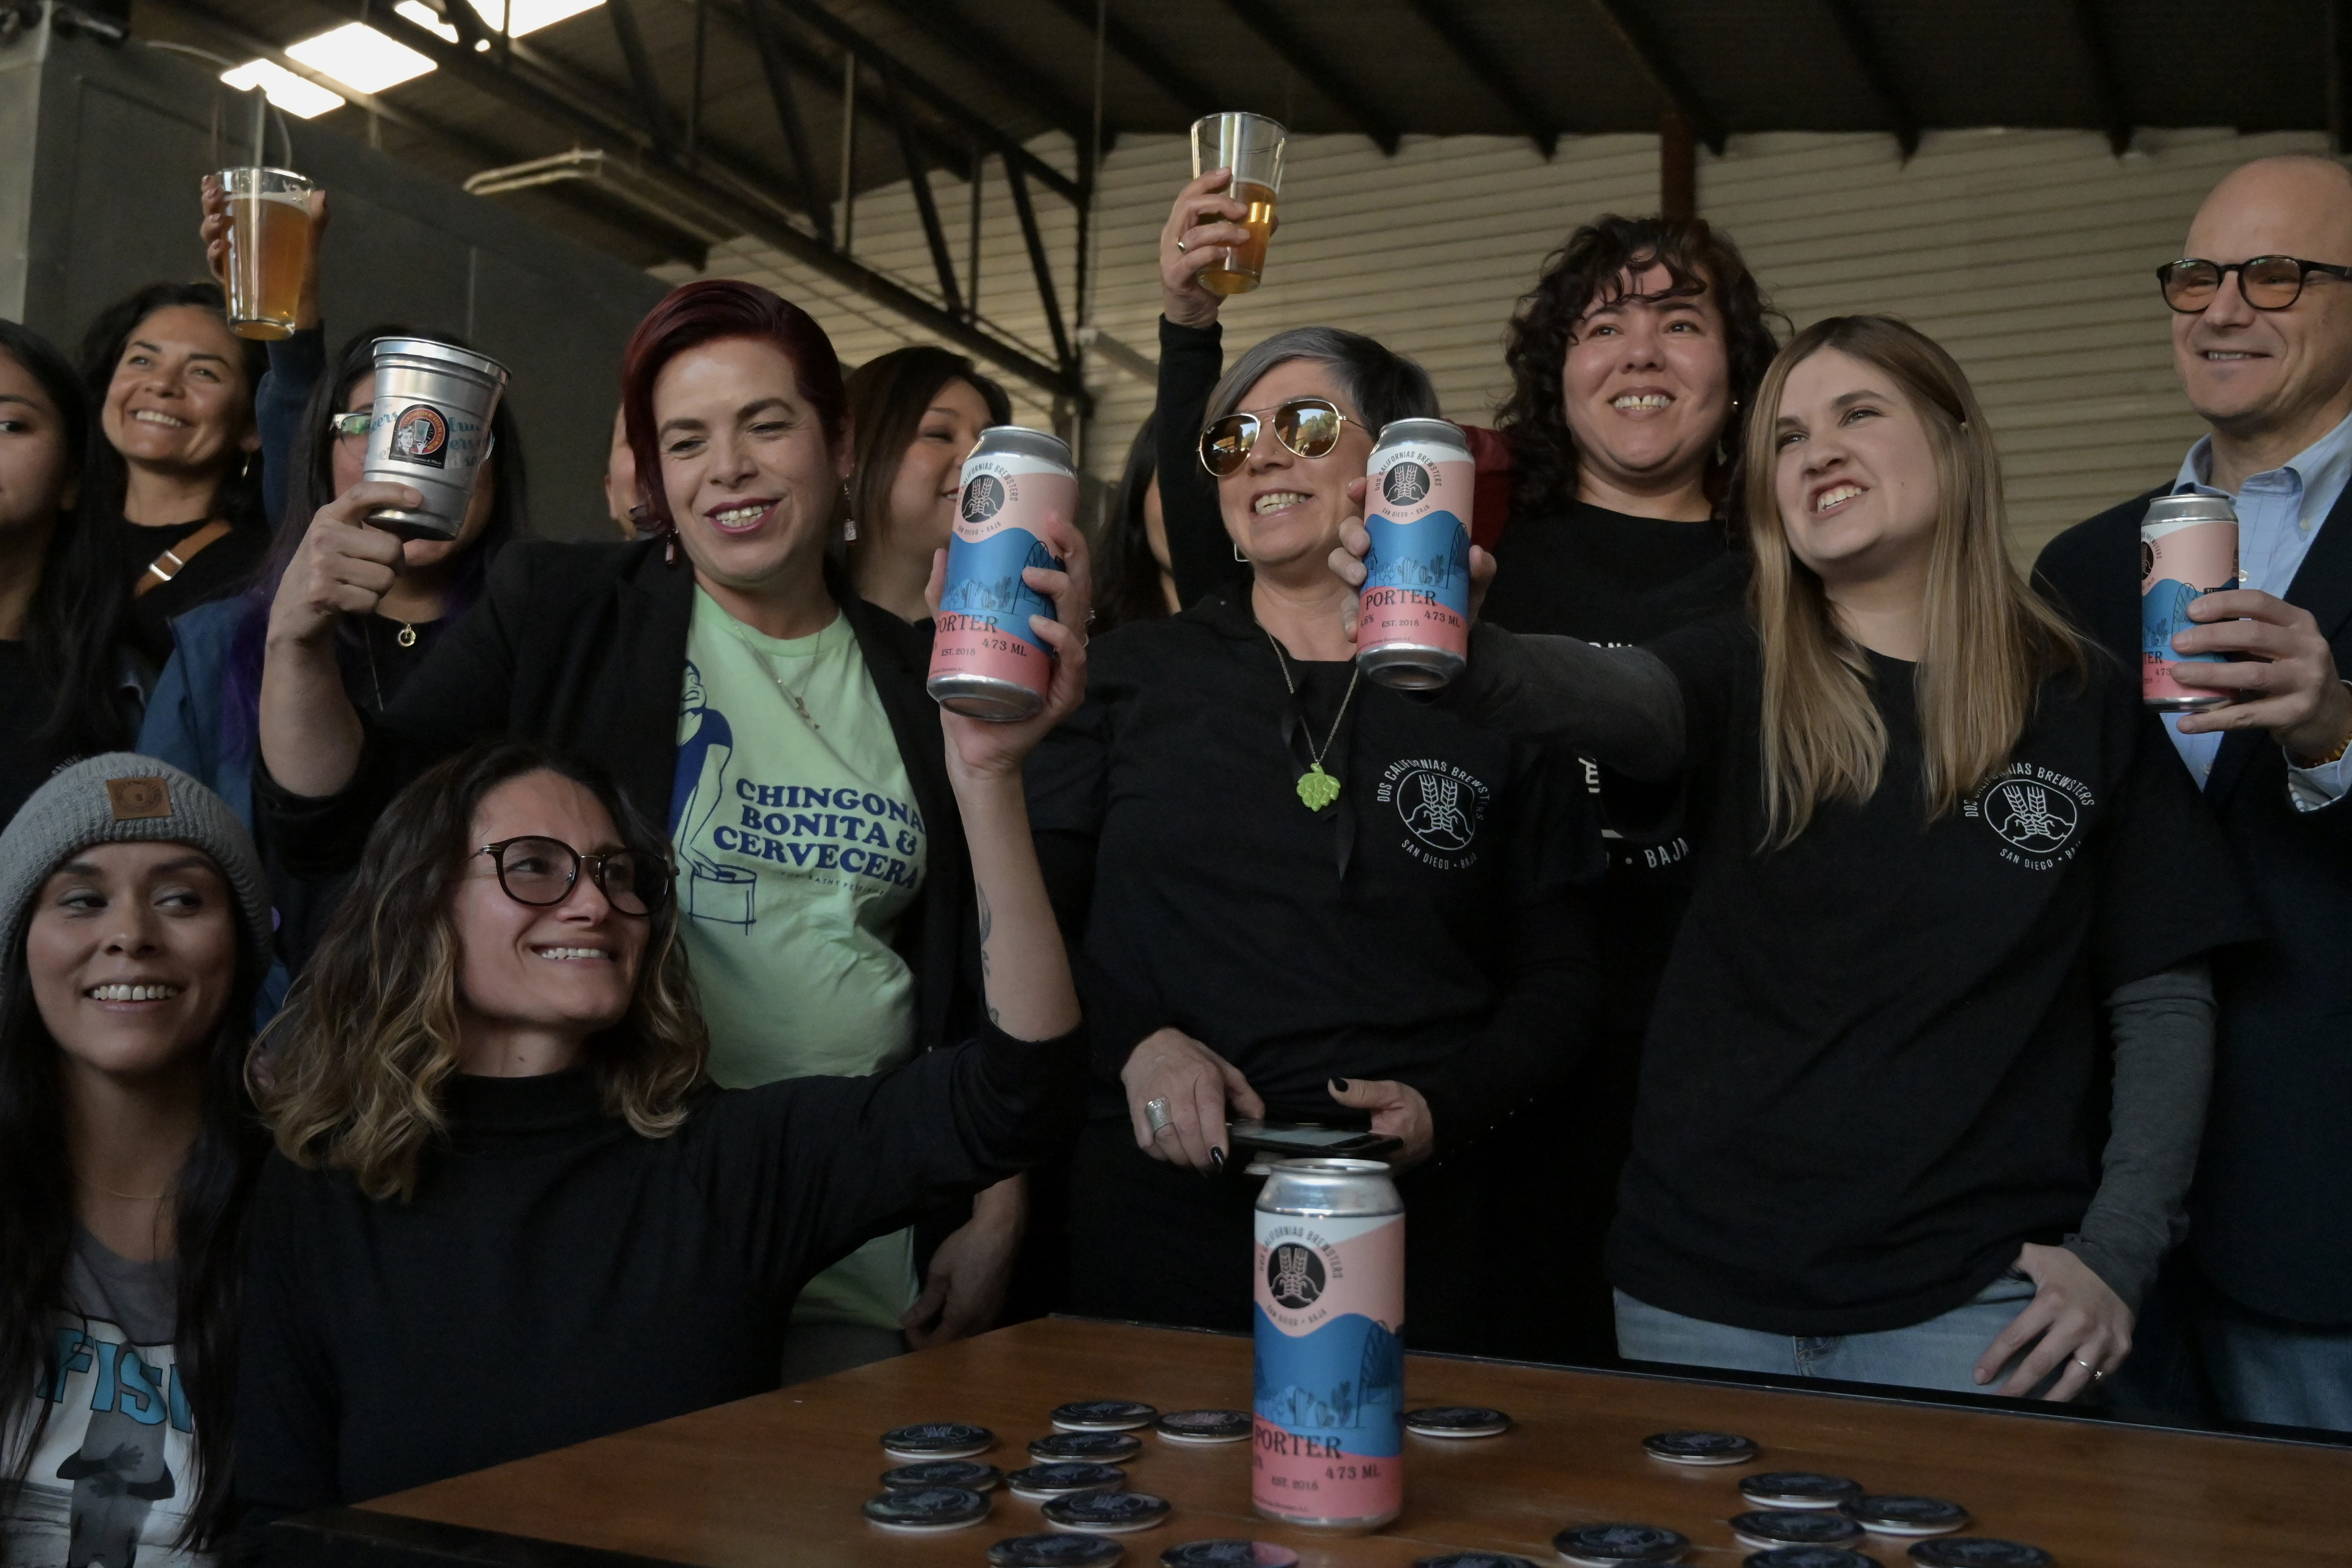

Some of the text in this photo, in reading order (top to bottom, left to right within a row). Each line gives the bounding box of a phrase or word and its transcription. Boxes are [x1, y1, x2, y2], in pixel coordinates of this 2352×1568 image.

[961, 463, 993, 489] CALIFORNIAS
[994, 465, 1018, 501] BREWSTERS
[1379, 451, 1415, 476] CALIFORNIAS
[1416, 453, 1442, 487] BREWSTERS
[1382, 508, 1391, 516] SAN
[1416, 504, 1430, 514] BAJA
[1366, 589, 1437, 611] PORTER
[1424, 611, 1445, 622] 473
[1449, 615, 1460, 628] ML
[956, 648, 975, 656] 2018
[982, 638, 1007, 651] 473
[1011, 643, 1027, 656] ML
[1384, 759, 1447, 781] CALIFORNIAS
[1377, 782, 1392, 802] DOS
[2037, 767, 2094, 806] BREWSTERS
[736, 778, 925, 835] CHINGONA
[740, 804, 917, 856] BONITA &
[713, 826, 918, 889] CERVECERA
[1402, 839, 1420, 857] SAN
[1423, 853, 1449, 869] DIEGO
[1644, 838, 1690, 868] BAJA
[2000, 848, 2020, 863] SAN
[2025, 859, 2053, 870] DIEGO
[809, 875, 841, 886] KATHY
[1306, 1230, 1343, 1278] BREWSTERS
[1325, 1466, 1356, 1479] 473
[1361, 1464, 1380, 1478] ML
